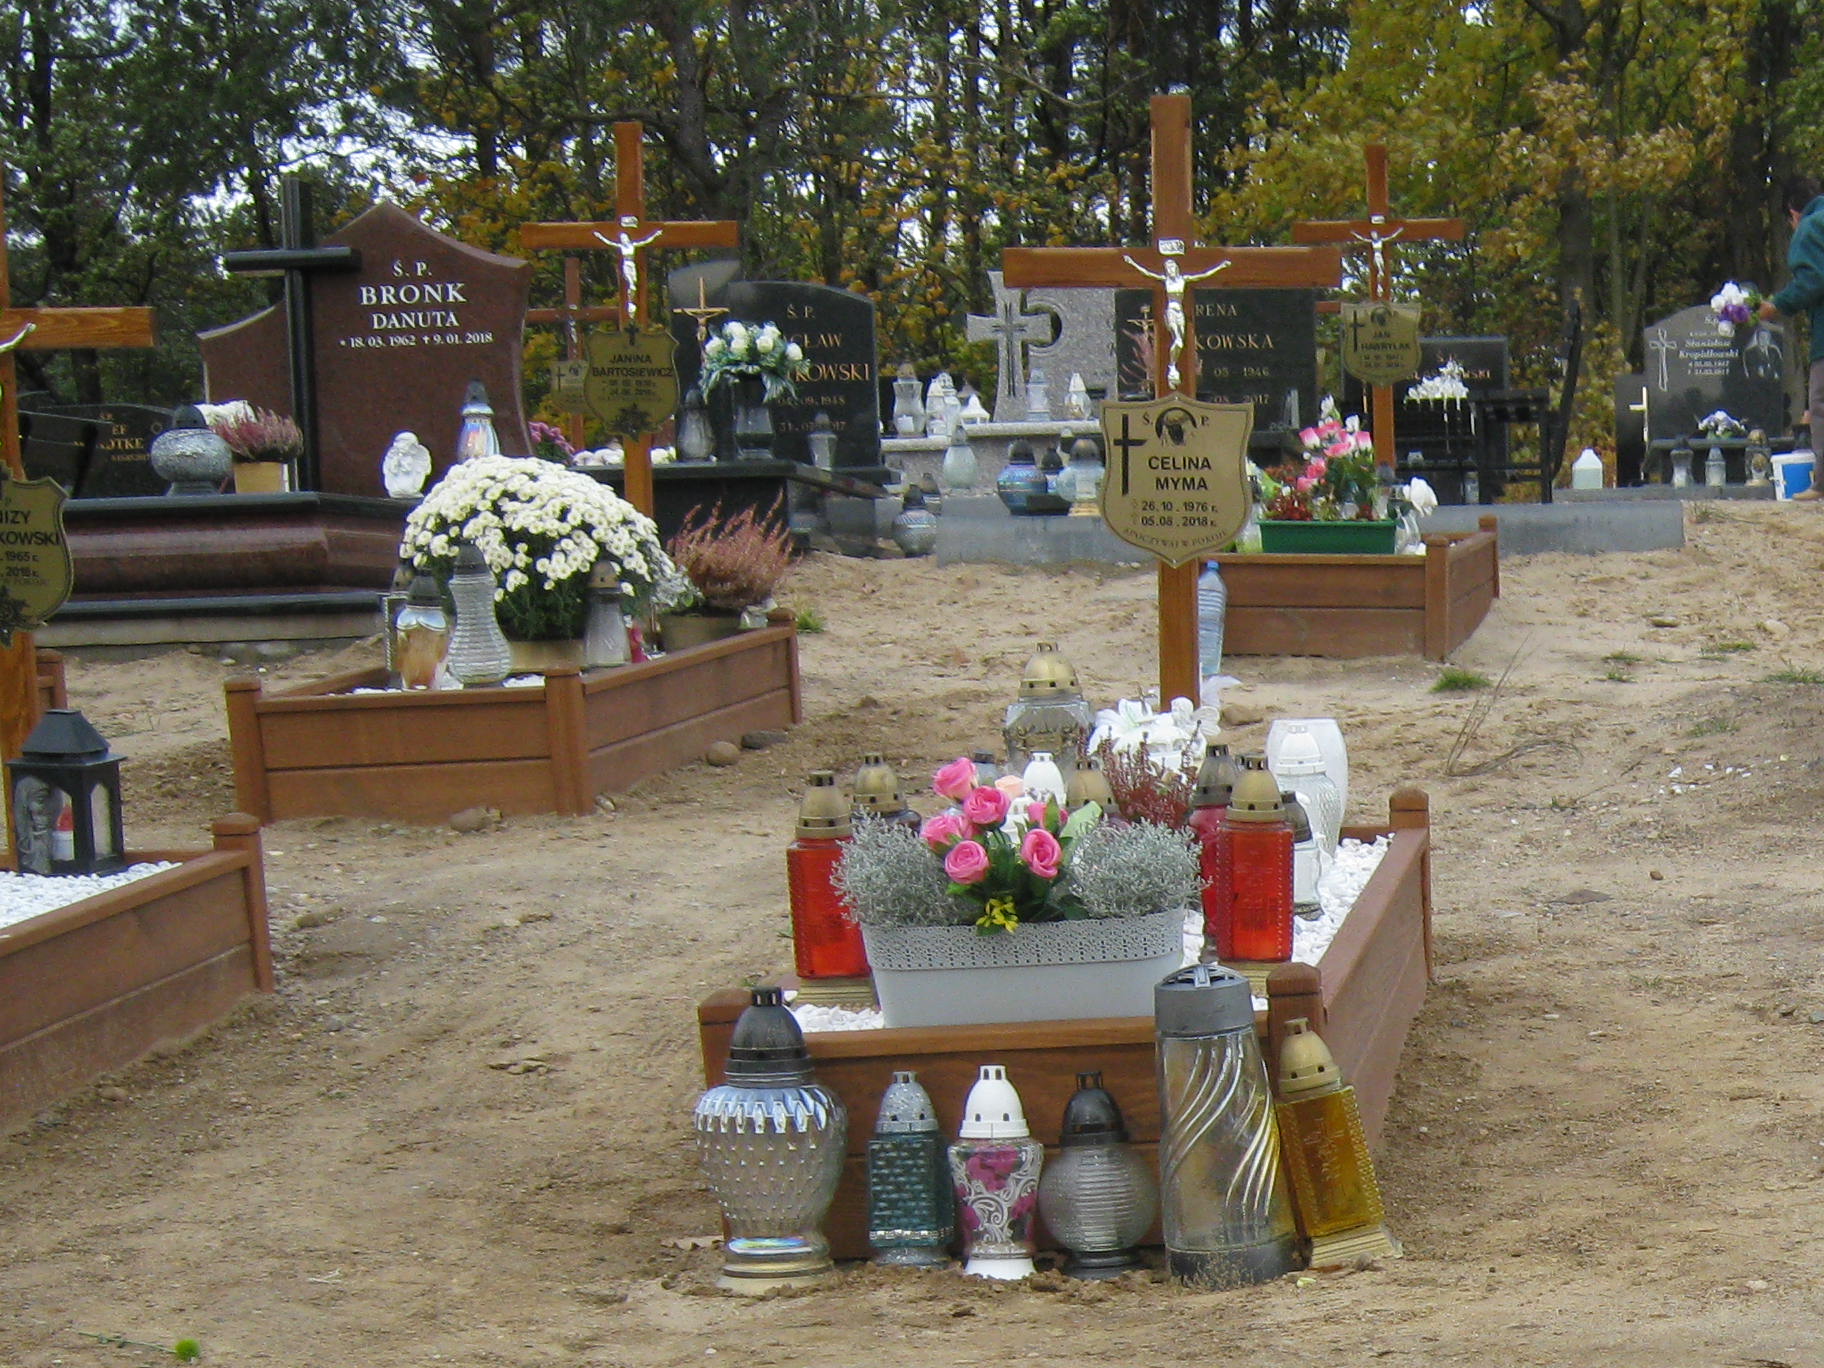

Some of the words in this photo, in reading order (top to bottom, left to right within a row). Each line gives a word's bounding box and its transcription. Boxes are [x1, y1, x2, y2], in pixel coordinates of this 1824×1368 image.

[360, 283, 467, 305] BRONK
[1195, 304, 1238, 317] RENA
[372, 311, 459, 329] DANUTA
[1195, 335, 1275, 350] KOWSKA
[610, 353, 652, 364] JANINA
[786, 363, 871, 383] KOWSKI
[1148, 456, 1212, 470] CELINA
[1156, 476, 1208, 491] MYMA
